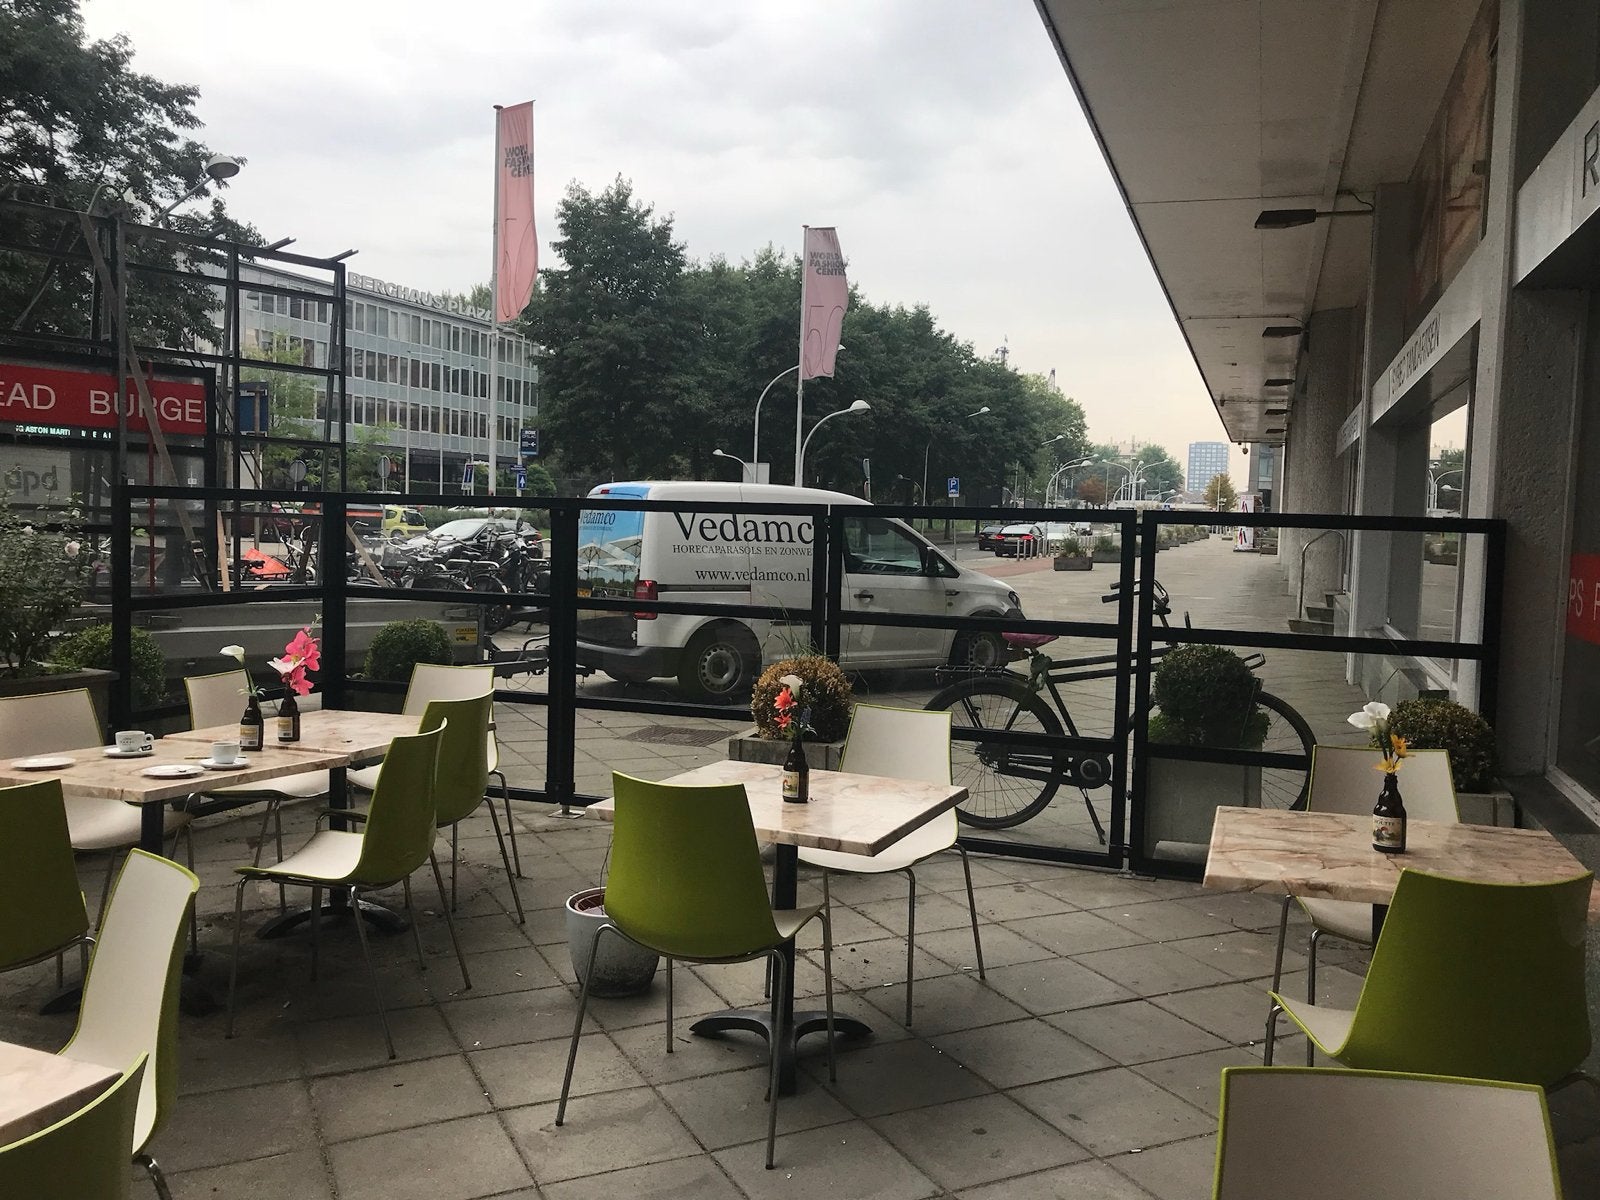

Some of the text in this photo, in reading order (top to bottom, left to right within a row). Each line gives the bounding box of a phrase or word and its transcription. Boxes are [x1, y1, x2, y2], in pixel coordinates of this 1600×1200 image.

[810, 251, 841, 260] WORLD
[347, 271, 445, 310] BERGHAUS
[89, 389, 207, 424] BURGE
[25, 426, 48, 434] ASTON
[673, 511, 829, 544] Vedamc
[672, 544, 762, 555] HORECAPARASOLS
[765, 546, 778, 556] EN
[695, 566, 811, 582] www.vedamco.nl
